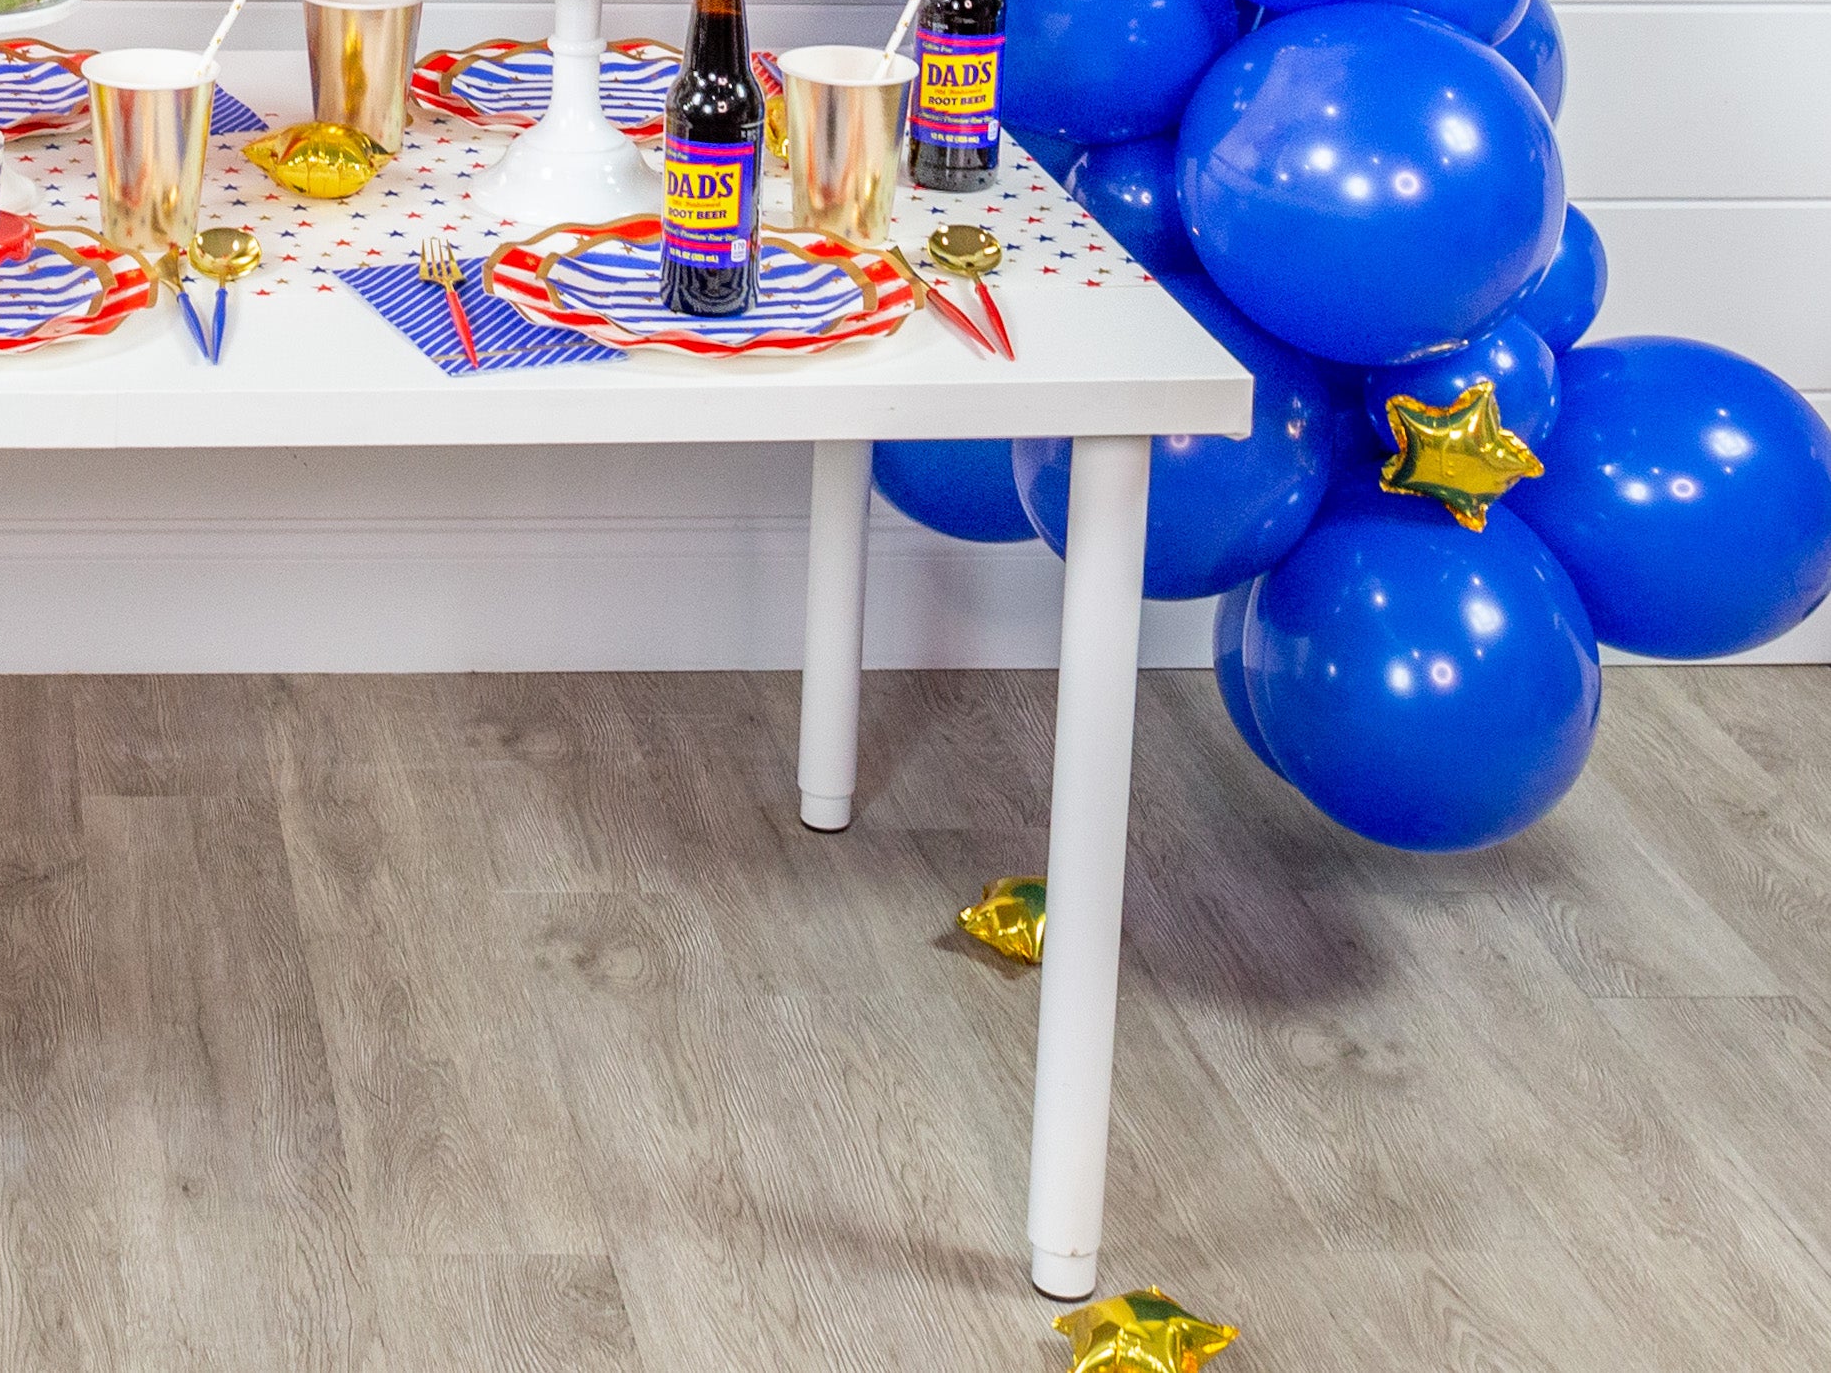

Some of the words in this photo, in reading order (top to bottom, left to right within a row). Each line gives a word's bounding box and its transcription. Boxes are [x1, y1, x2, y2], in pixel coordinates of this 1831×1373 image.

[927, 61, 992, 86] DAD'S
[929, 96, 957, 105] ROOT
[961, 95, 986, 105] BEER
[668, 171, 733, 199] DAD'S
[697, 210, 727, 219] BEER
